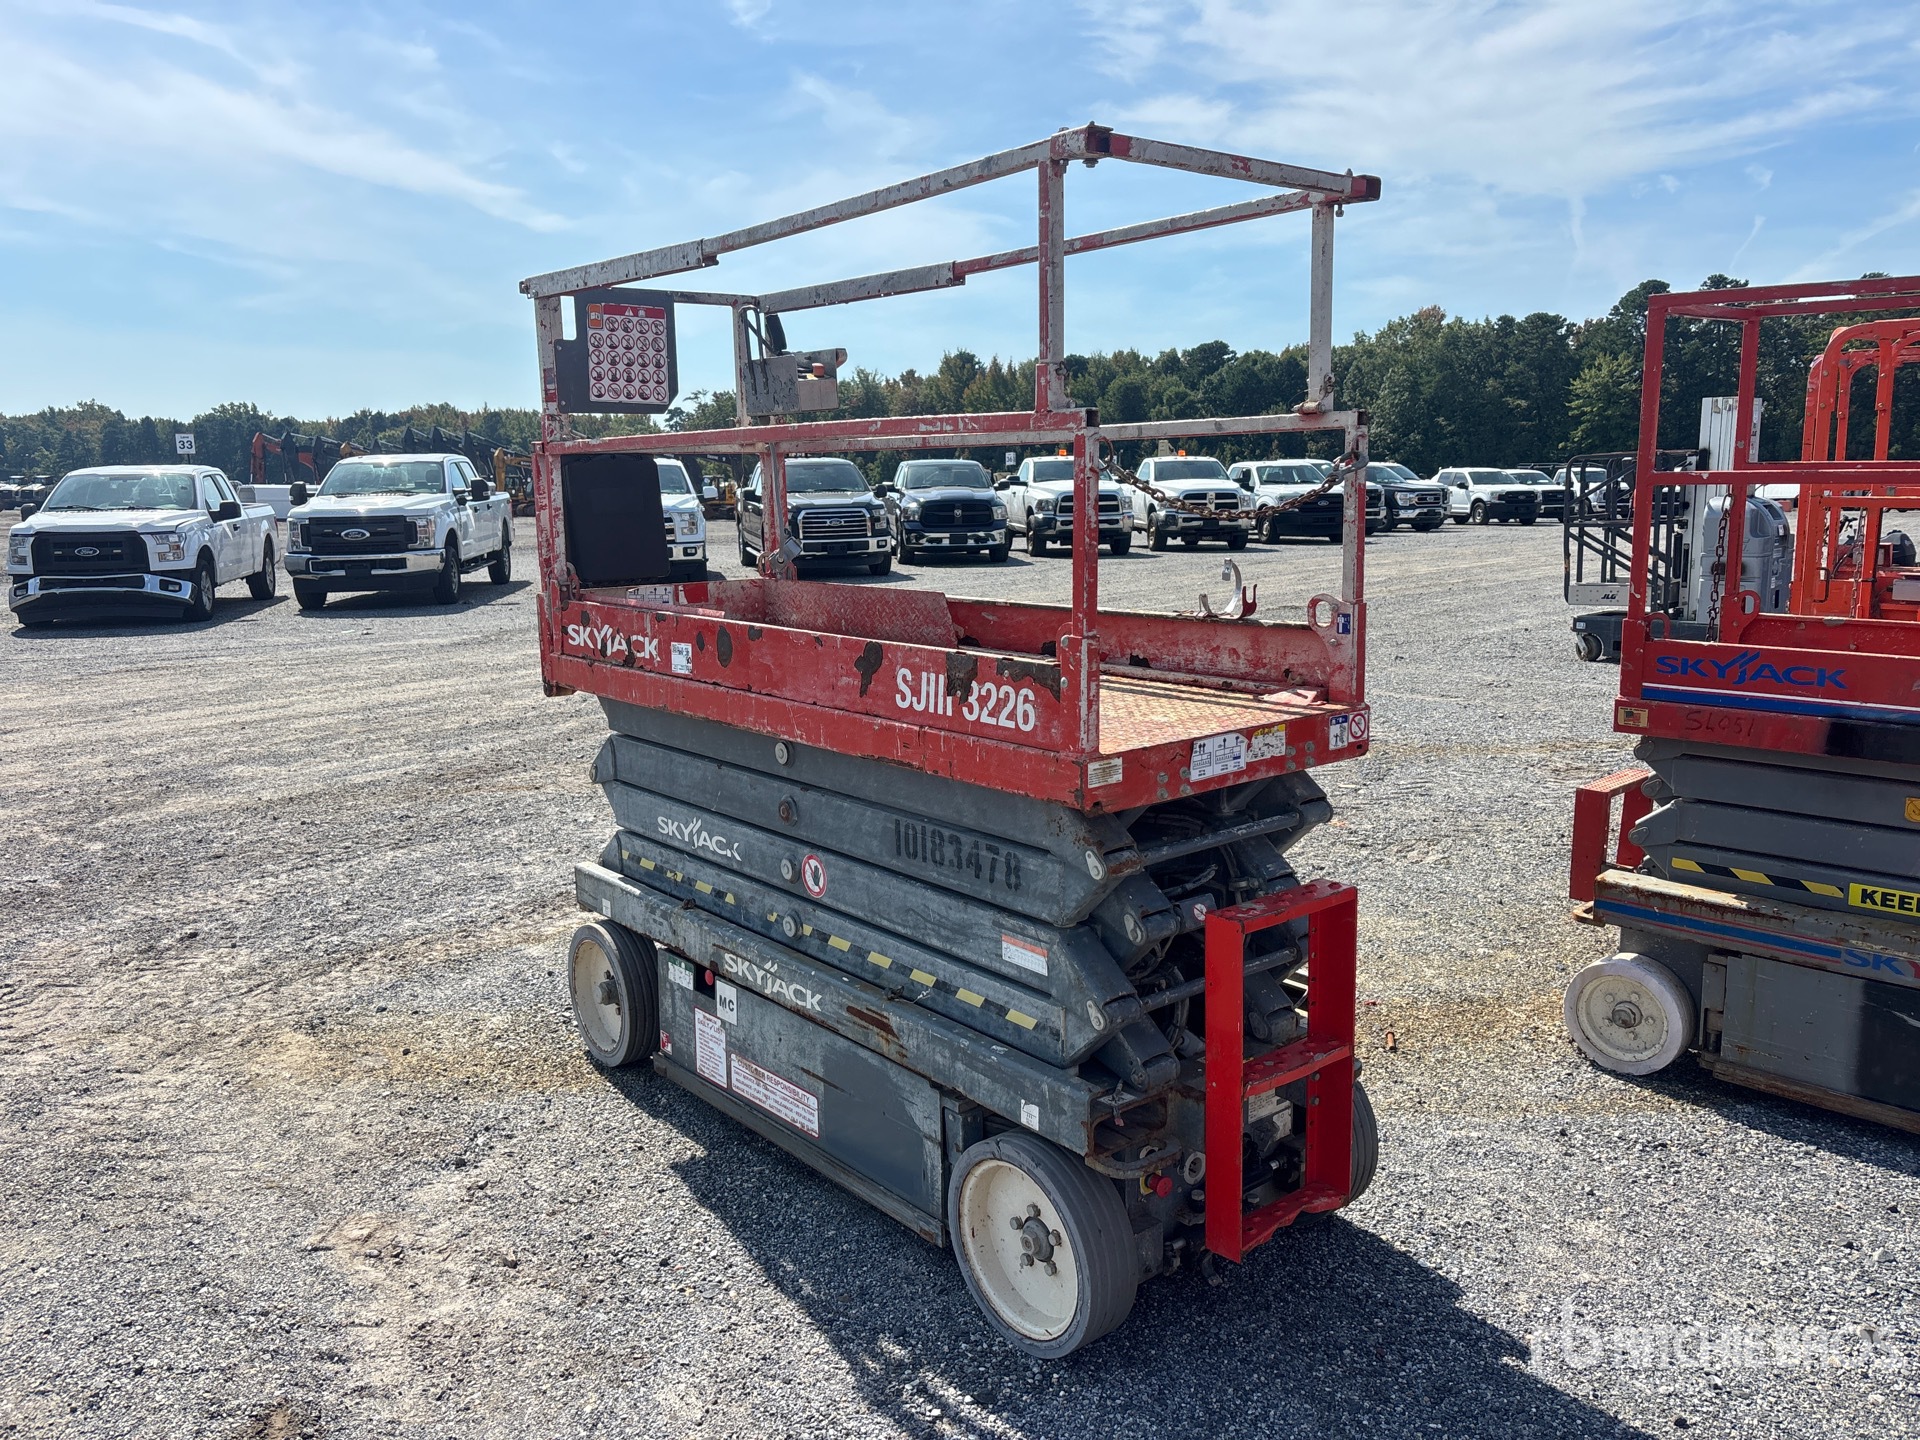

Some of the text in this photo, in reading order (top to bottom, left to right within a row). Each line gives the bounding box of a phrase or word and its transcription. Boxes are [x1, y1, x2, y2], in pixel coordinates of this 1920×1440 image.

[178, 440, 193, 450] 33
[567, 624, 661, 661] SKYJACK
[1655, 650, 1849, 690] SKYJACK
[962, 680, 1036, 732] 3226
[657, 816, 742, 862] SKYJACK
[895, 818, 1021, 892] 10183478
[1861, 888, 1920, 913] KEE
[724, 952, 823, 1012] SKYJACK
[719, 994, 735, 1012] MC
[766, 1074, 809, 1104] RESPONSIBILITY
